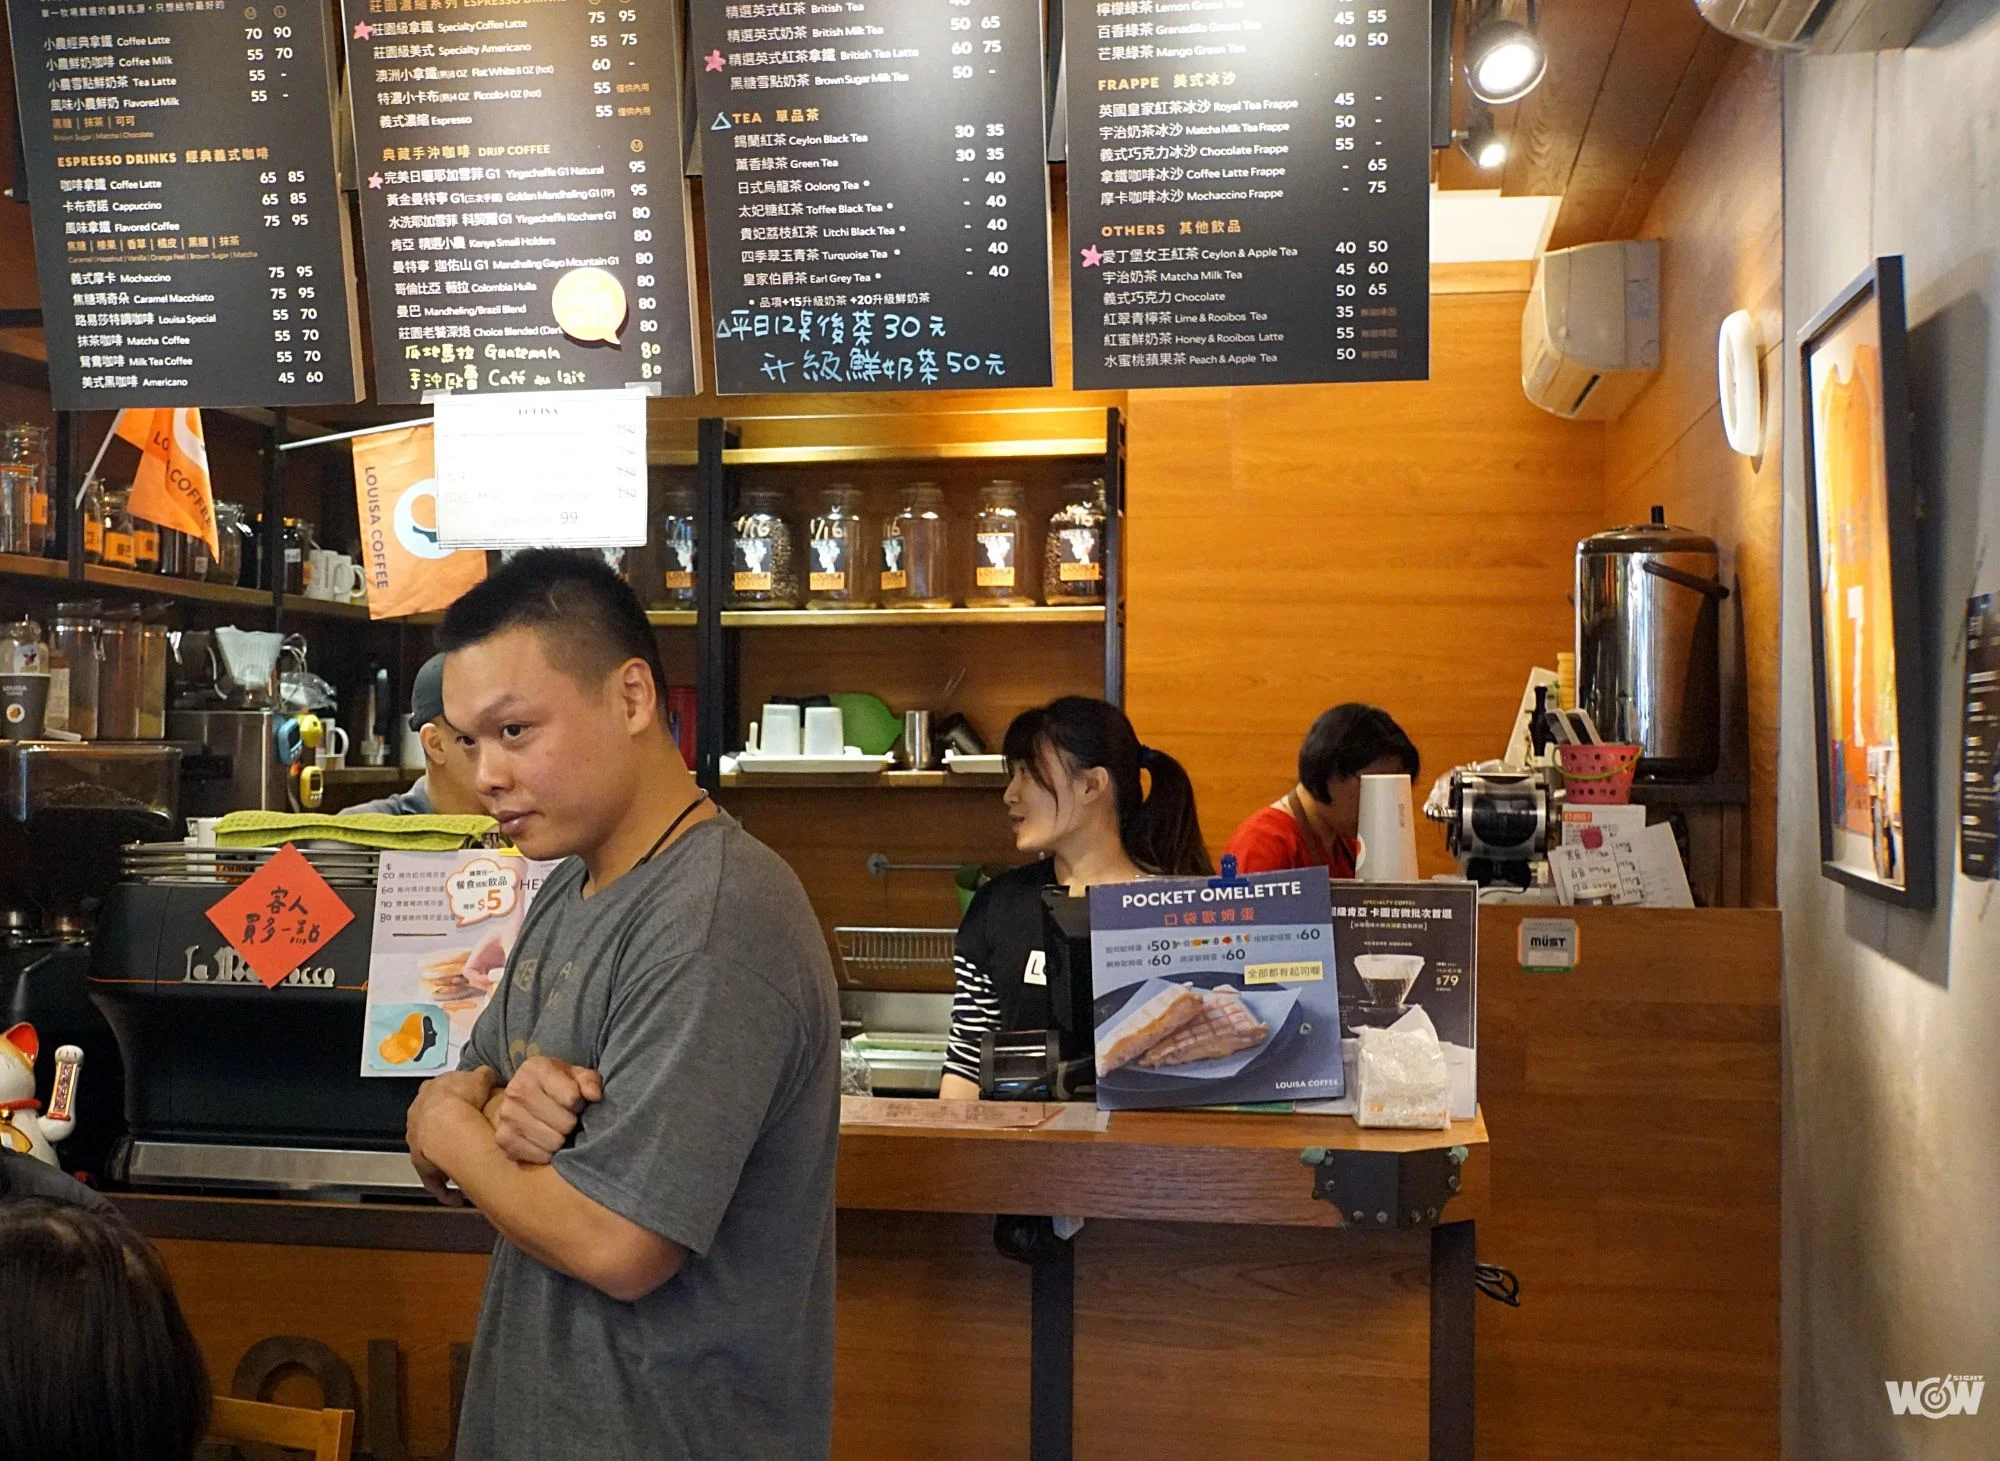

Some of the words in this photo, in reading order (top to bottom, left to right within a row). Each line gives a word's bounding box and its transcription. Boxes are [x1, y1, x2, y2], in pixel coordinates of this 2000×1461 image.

[117, 37, 146, 46] Coffee
[245, 28, 262, 39] 70
[274, 27, 291, 38] 90
[1098, 77, 1159, 90] FRAPPE
[732, 113, 761, 123] TEA
[776, 108, 819, 122] 單品茶
[734, 133, 786, 148] 錫蘭紅茶
[789, 136, 822, 146] Ceylon
[824, 134, 849, 143] Black
[850, 134, 868, 142] Tea
[955, 125, 974, 138] 30
[986, 124, 1004, 136] 35
[478, 147, 505, 156] DRIP
[507, 144, 550, 155] COFFEE
[736, 157, 788, 171] 薰香綠茶
[790, 160, 819, 168] Green
[820, 159, 838, 167] Tea
[956, 149, 975, 161] 30
[987, 148, 1004, 160] 35
[1100, 144, 1197, 162] 義式巧克力冰沙
[1200, 146, 1252, 156] Chocolate
[1254, 145, 1289, 155] Frappe
[1336, 138, 1354, 150] 55
[58, 155, 122, 167] ESPRESSO
[126, 153, 176, 164] DRINKS
[738, 180, 802, 194] 日式烏龍茶
[805, 182, 840, 192] Oolong
[841, 181, 859, 189] Tea
[985, 171, 1005, 183] 40
[112, 201, 162, 212] Cappuccino
[262, 194, 278, 205] 65
[290, 193, 306, 204] 85
[739, 203, 803, 217] 太妃糖紅茶
[806, 205, 837, 214] Toffee
[839, 204, 863, 213] Black
[865, 204, 882, 212] Tea
[986, 195, 1006, 207] 40
[1102, 224, 1165, 236] OTHERS
[1180, 220, 1240, 234] 其他飲品
[742, 248, 819, 263] 四季翠玉青茶
[822, 251, 868, 261] Turquoise
[870, 250, 887, 258] Tea
[988, 242, 1008, 253] 40
[1102, 247, 1198, 263] 愛丁堡女王紅茶
[1202, 250, 1236, 260] Ceylon
[1238, 249, 1245, 257] &
[1248, 248, 1277, 258] Apple
[1279, 247, 1297, 256] Tea
[1336, 242, 1356, 253] 40
[1369, 241, 1388, 252] 50
[120, 274, 171, 282] Mochaccino
[269, 267, 284, 278] 75
[297, 266, 313, 277] 95
[744, 272, 807, 286] 皇家伯爵茶
[810, 275, 827, 283] Earl
[829, 274, 852, 284] Grey
[853, 274, 871, 282] Tea
[989, 265, 1008, 277] 40
[1103, 270, 1157, 284] 宇治奶茶
[1161, 272, 1199, 281] Matcha
[1201, 271, 1222, 280] Milk
[1224, 271, 1242, 279] Tea
[1336, 263, 1355, 275] 45
[1369, 262, 1388, 274] 60
[471, 283, 513, 292] Colombia
[637, 275, 654, 287] 80
[1104, 291, 1171, 305] 義式巧克力
[1175, 292, 1225, 302] Chocolate
[1337, 285, 1355, 296] 50
[1369, 284, 1386, 295] 65
[502, 304, 526, 314] Blend
[639, 298, 656, 309] 80
[159, 316, 185, 324] Louisa
[186, 314, 216, 324] Special
[273, 309, 288, 320] 55
[300, 308, 317, 319] 70
[127, 337, 159, 345] Matcha
[162, 336, 190, 344] Coffee
[275, 330, 290, 341] 55
[302, 329, 319, 340] 70
[641, 342, 660, 358] 80
[1105, 352, 1186, 367] 水蜜桃蘋果茶
[1190, 355, 1217, 364] Peach
[1219, 355, 1226, 363] &
[1228, 355, 1256, 364] Apple
[1260, 354, 1277, 362] Tea
[1337, 348, 1355, 360] 50
[143, 378, 188, 386] Americano
[279, 372, 295, 383] 45
[306, 372, 323, 382] 60
[489, 369, 525, 386] Café
[534, 375, 550, 385] au
[557, 370, 585, 384] lait
[642, 363, 661, 378] 80
[365, 466, 380, 525] LOUISA
[372, 527, 389, 589] COFFEE
[266, 885, 308, 915] 客人
[1122, 890, 1196, 908] POCKET
[1200, 881, 1301, 902] OMELETTE
[1165, 908, 1256, 926] 口袋歐姆蛋
[1436, 975, 1458, 986] $79
[1276, 1079, 1306, 1088] LOUISA
[1308, 1079, 1338, 1088] COFFEE
